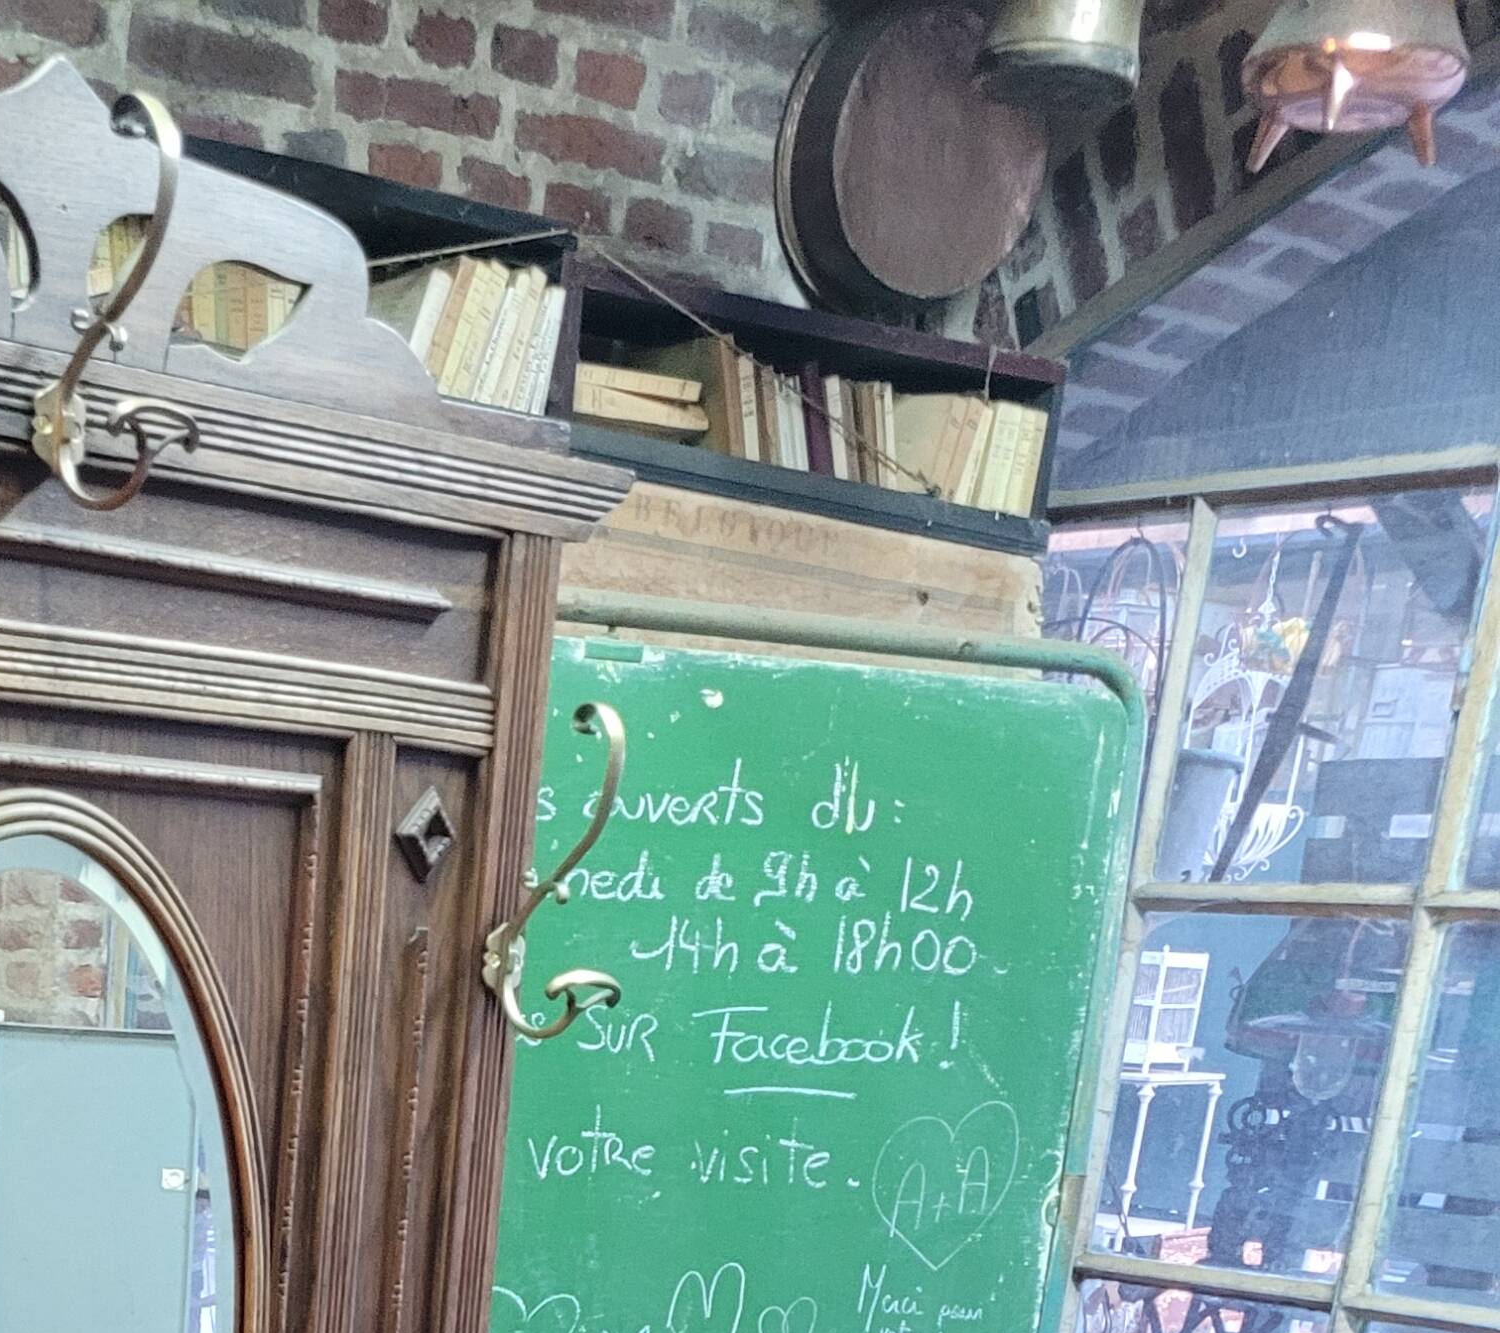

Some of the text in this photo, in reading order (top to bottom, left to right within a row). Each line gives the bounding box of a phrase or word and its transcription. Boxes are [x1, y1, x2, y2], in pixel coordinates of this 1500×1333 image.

[695, 853, 736, 901] de
[753, 850, 819, 907] 9h
[835, 855, 871, 902] à
[900, 856, 975, 922] 12h
[629, 915, 740, 974] 14h
[757, 918, 799, 974] à
